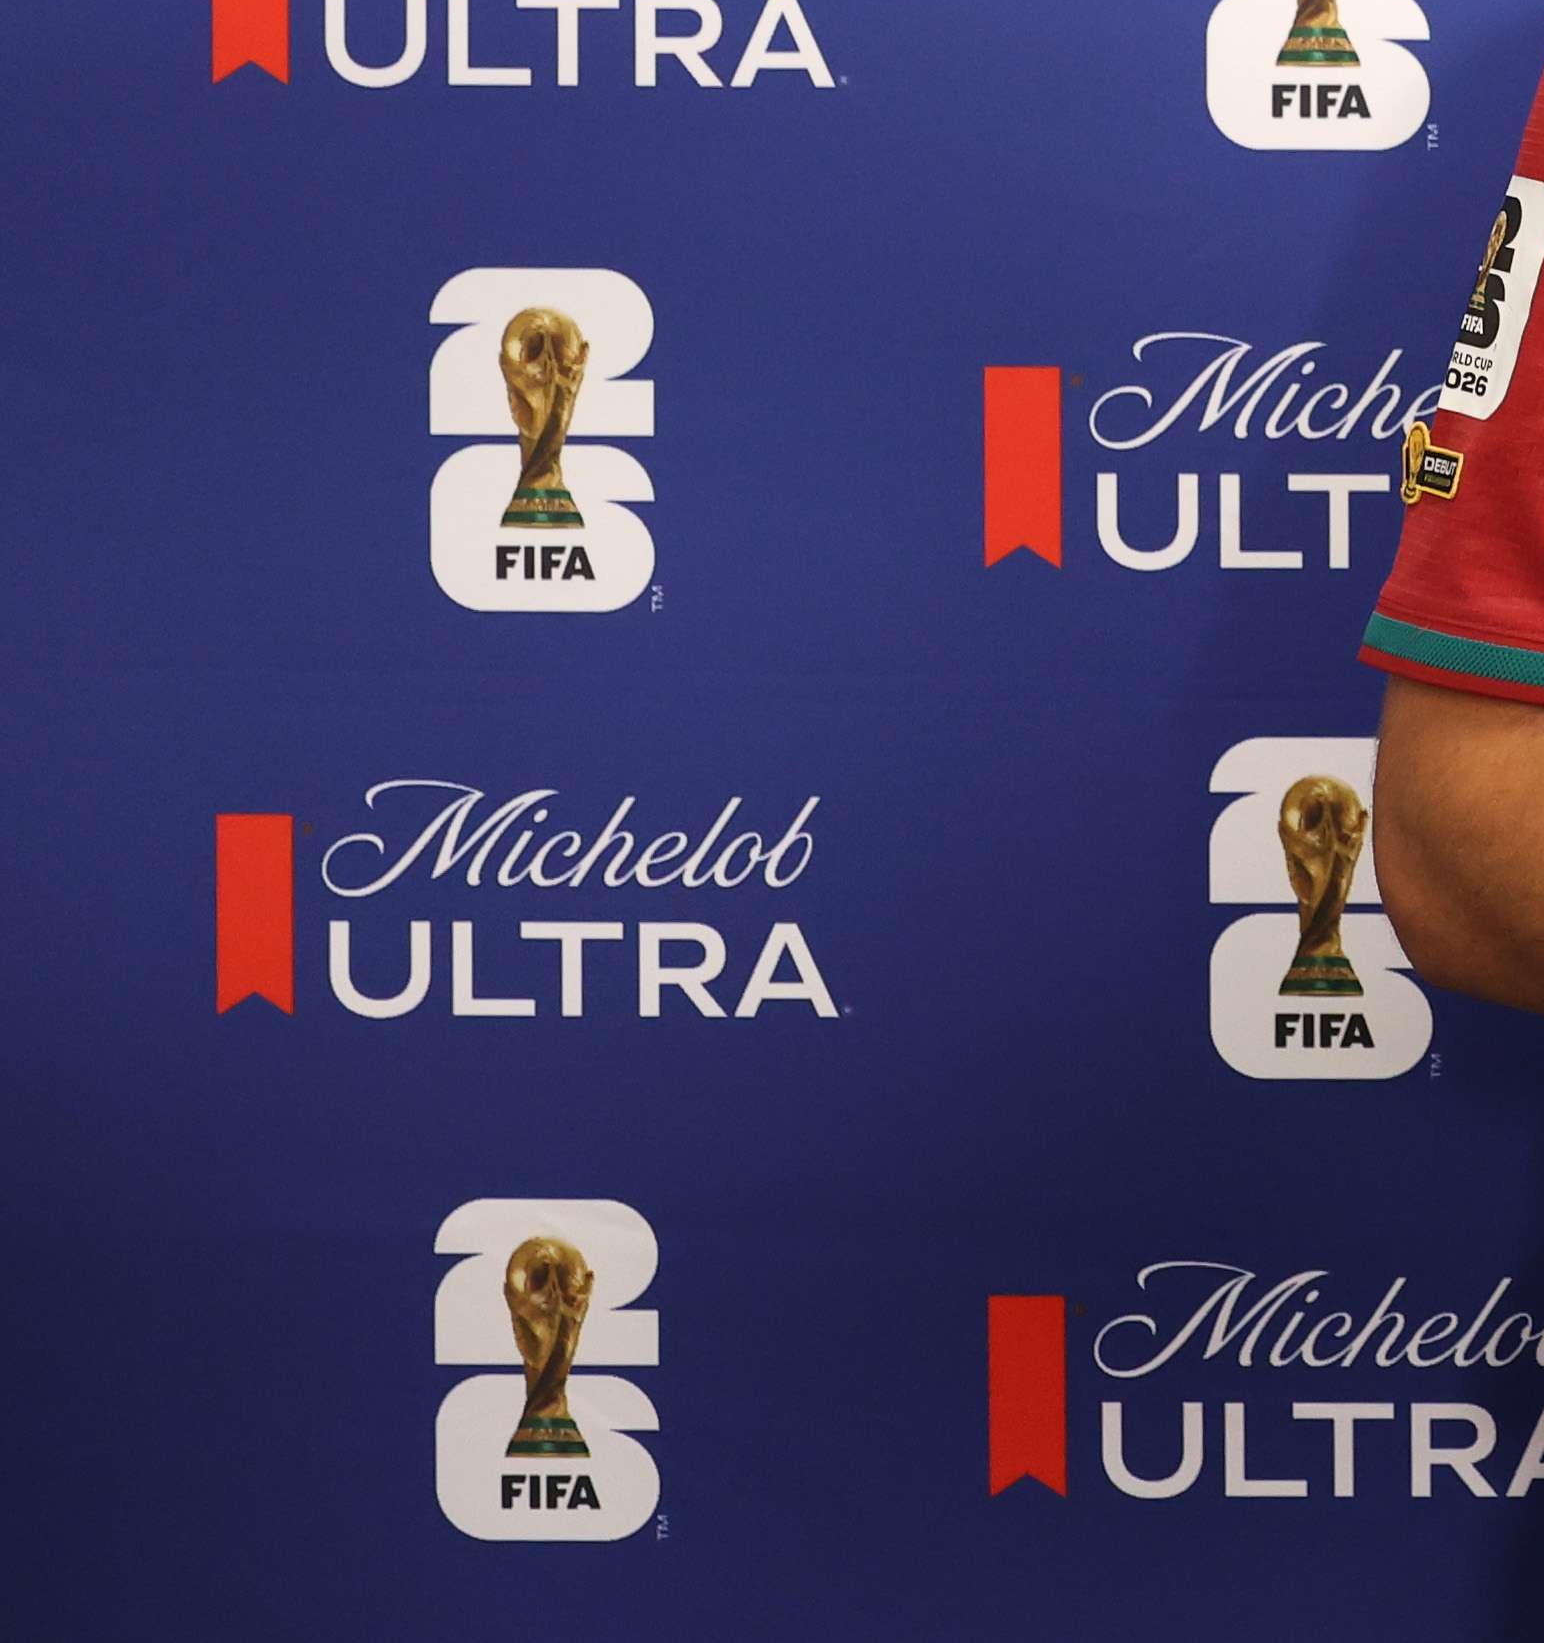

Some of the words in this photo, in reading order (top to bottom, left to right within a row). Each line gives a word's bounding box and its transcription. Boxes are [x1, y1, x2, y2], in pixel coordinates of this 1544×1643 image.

[1273, 85, 1370, 117] FIFA
[1461, 314, 1484, 335] FIFA
[1474, 357, 1493, 371] CUP
[1424, 456, 1457, 476] DEBUT
[1097, 473, 1389, 570] ULT
[496, 546, 594, 579] FIFA
[322, 780, 819, 896] Michelob
[330, 921, 838, 1018] ULTRA
[1275, 1014, 1374, 1048] FIFA
[502, 1475, 600, 1509] FIFA
